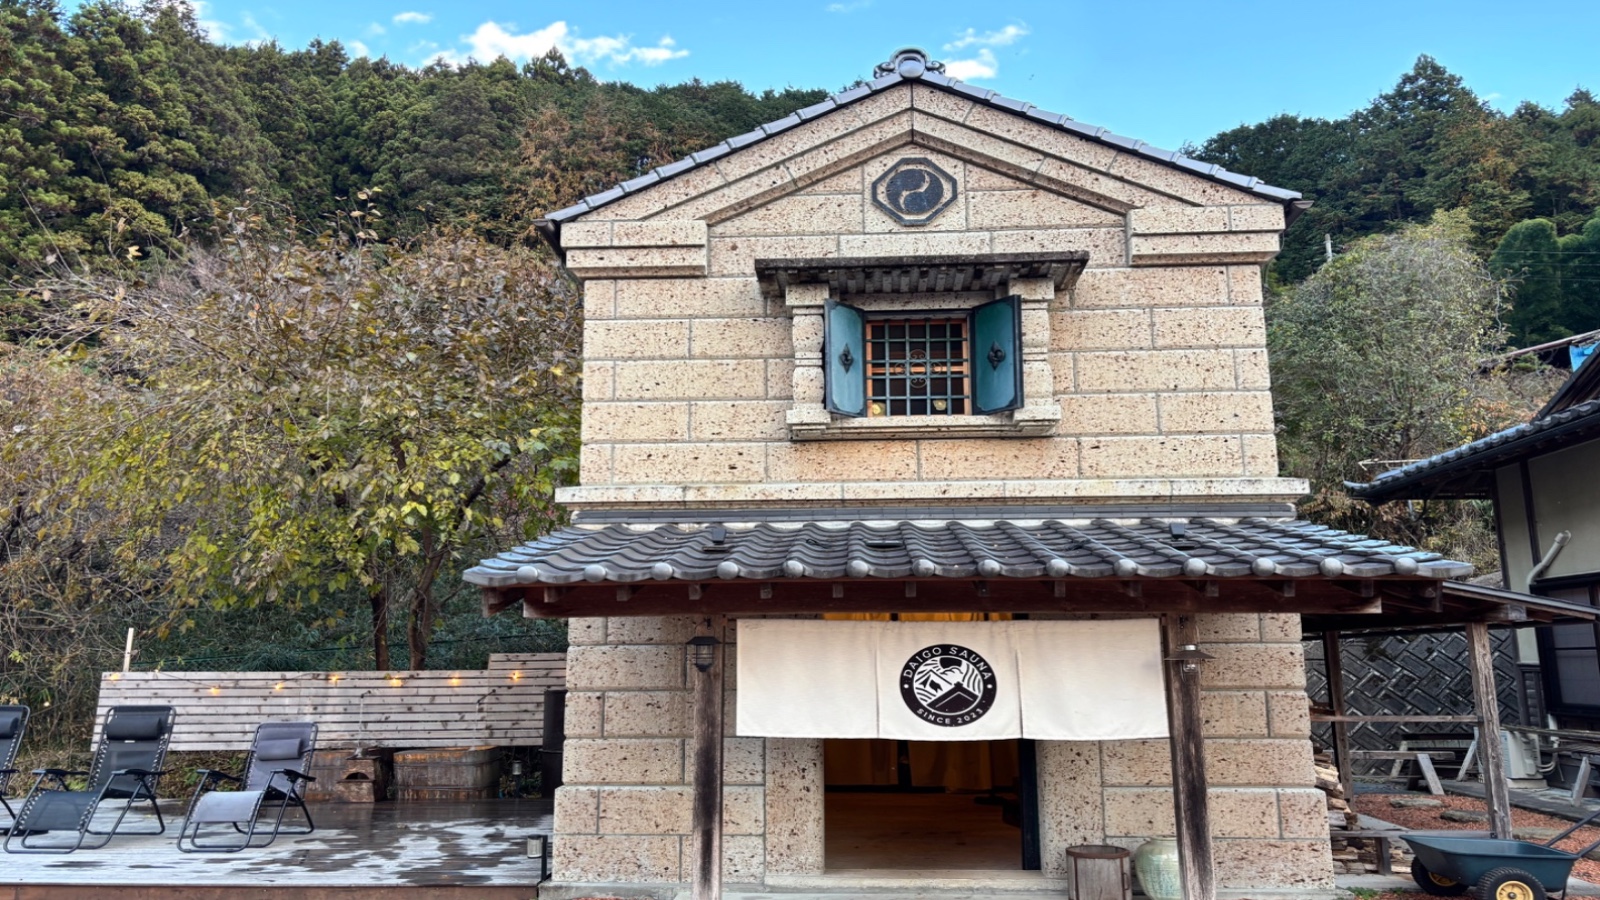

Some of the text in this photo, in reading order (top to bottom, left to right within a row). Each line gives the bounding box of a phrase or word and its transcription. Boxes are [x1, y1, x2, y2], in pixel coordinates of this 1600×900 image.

[903, 647, 993, 680] DAIGO SAUNA
[916, 708, 951, 724] SINCE
